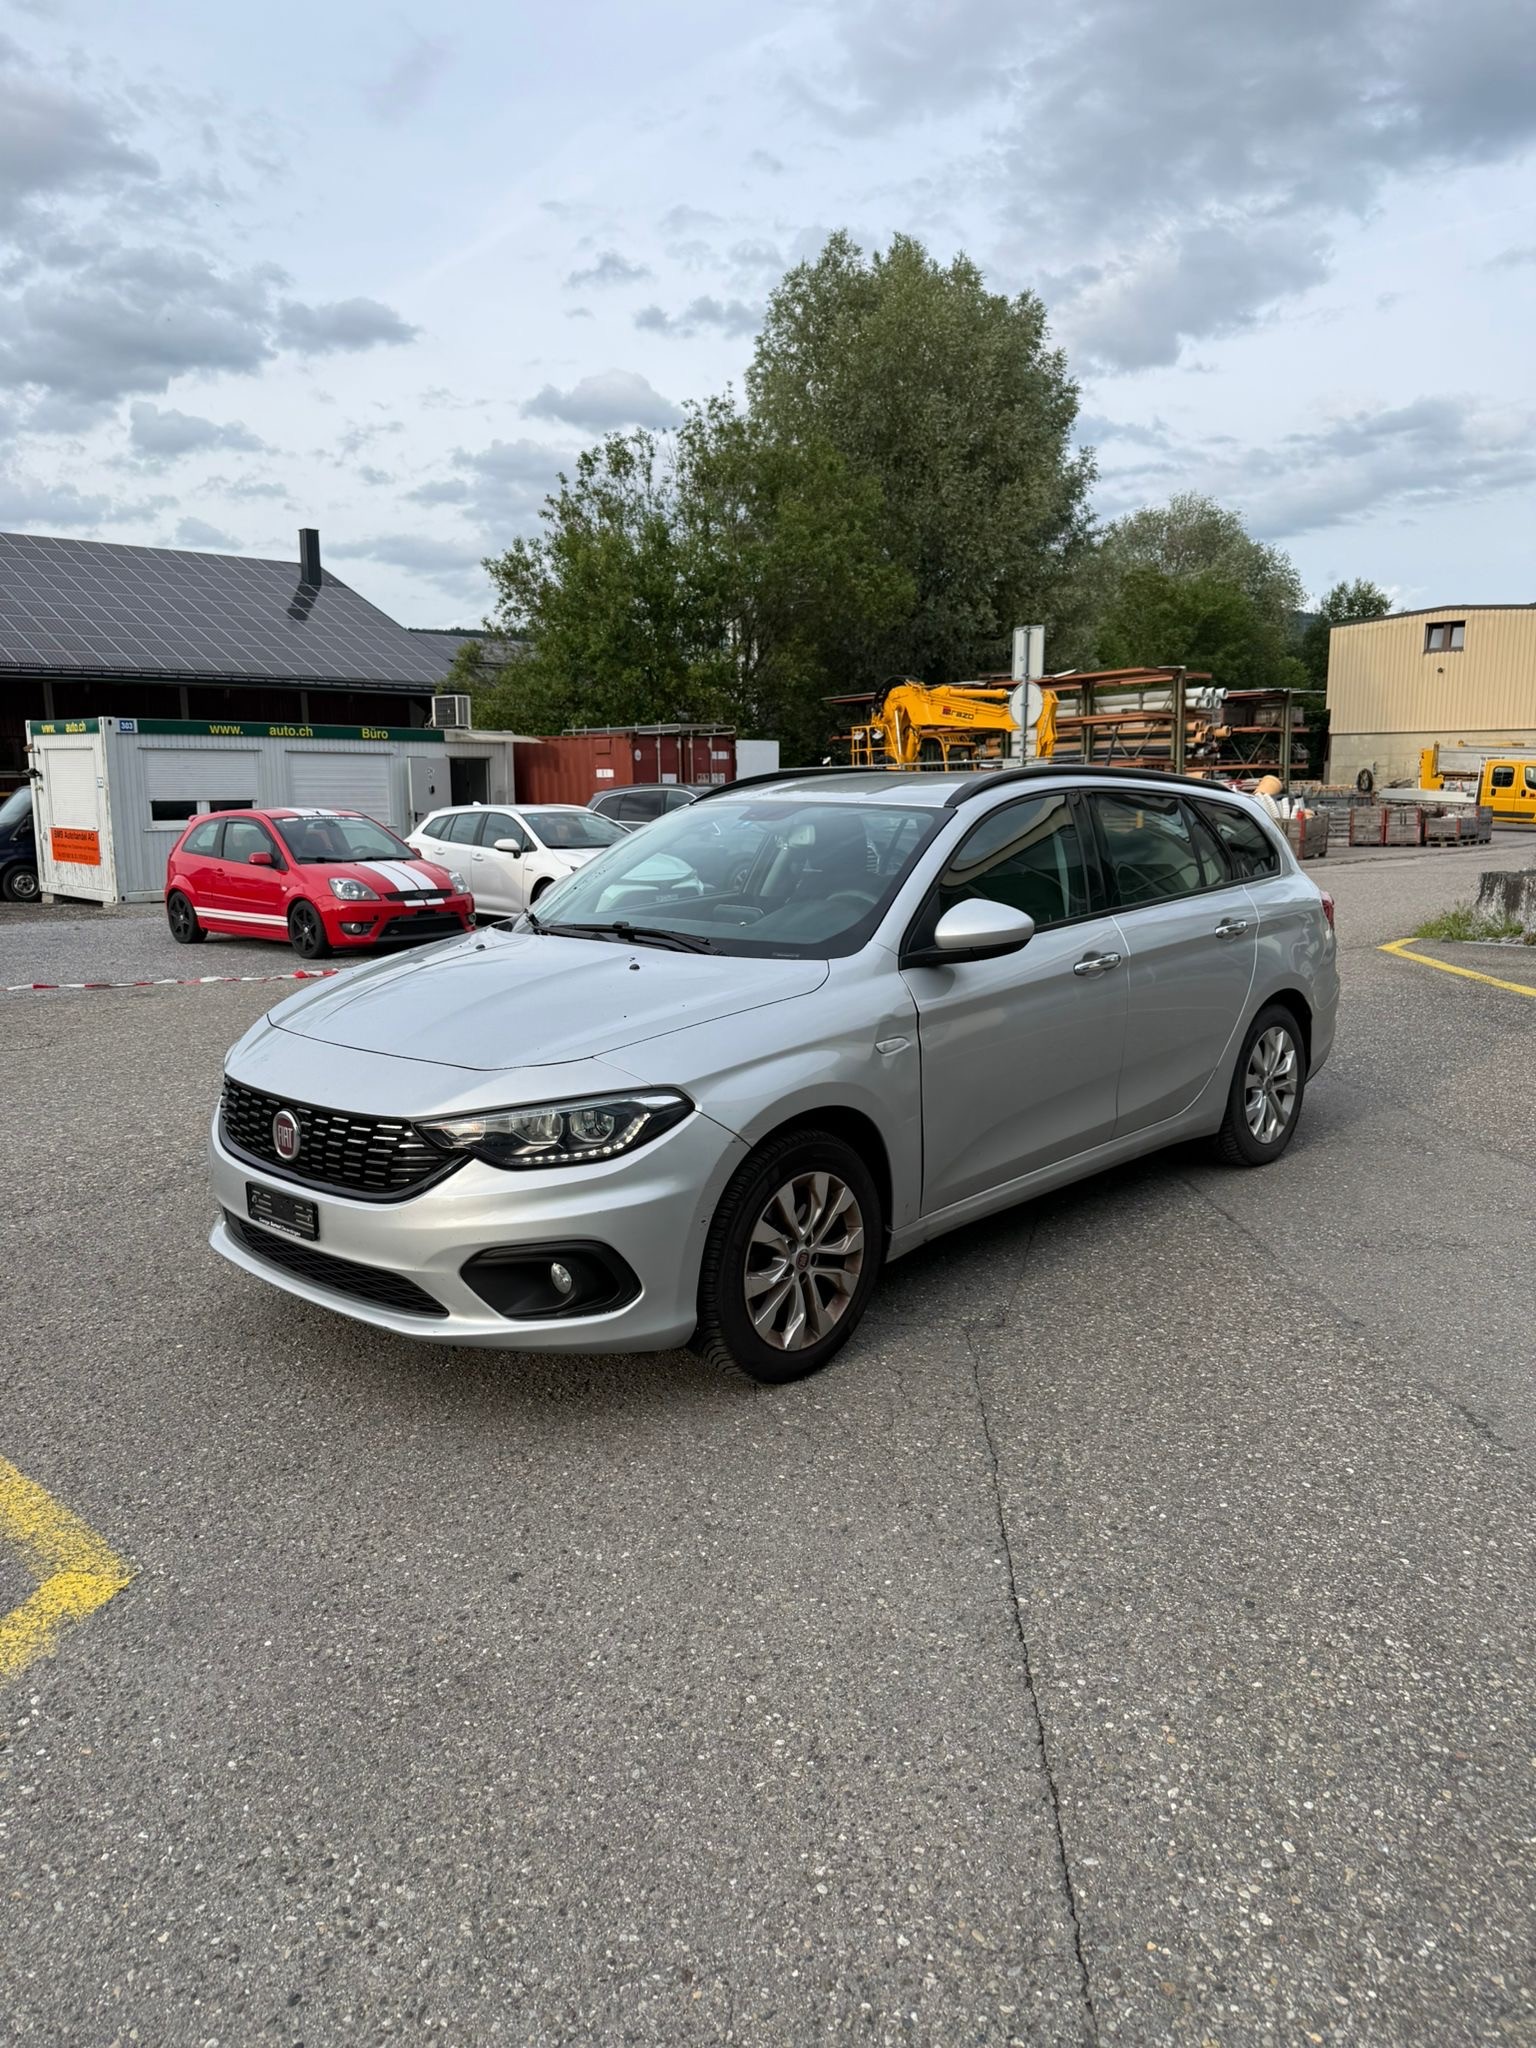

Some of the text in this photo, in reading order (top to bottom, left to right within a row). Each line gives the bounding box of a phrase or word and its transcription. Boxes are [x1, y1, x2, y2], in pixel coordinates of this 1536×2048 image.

[65, 721, 87, 733] auto.ch
[209, 724, 389, 740] www. auto.ch Büro
[88, 832, 95, 841] AG
[277, 1124, 293, 1149] FIAT
